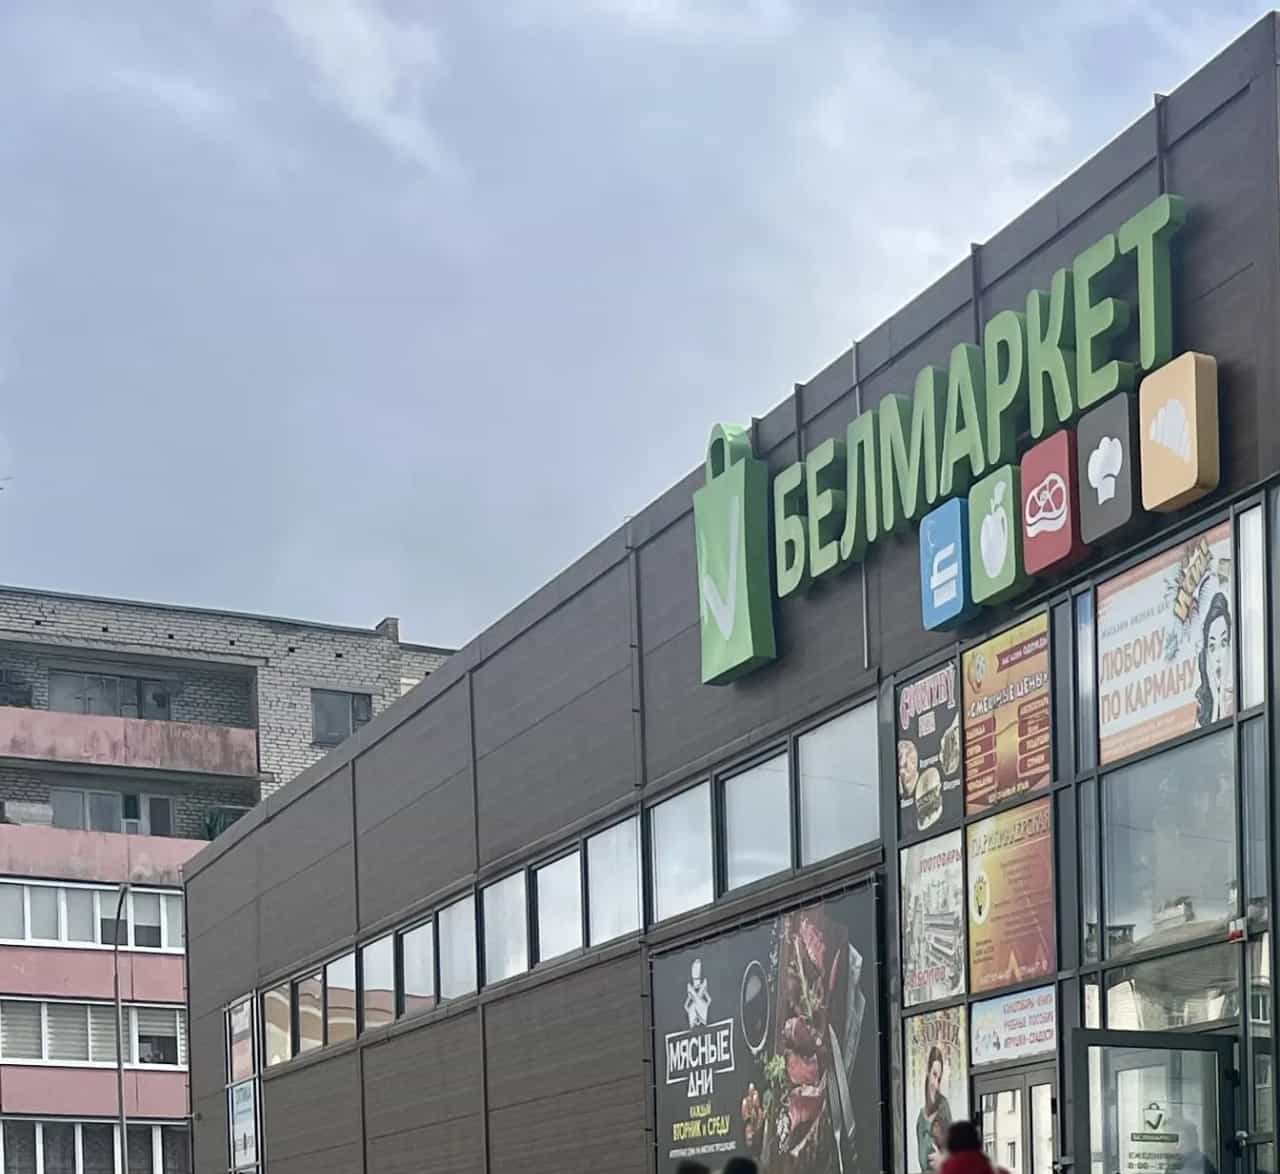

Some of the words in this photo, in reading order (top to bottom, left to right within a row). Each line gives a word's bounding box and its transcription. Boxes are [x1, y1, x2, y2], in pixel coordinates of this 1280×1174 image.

[774, 193, 1184, 598] БЕЛМАРКЕТ
[1100, 627, 1166, 684] ЛЮБОМУ
[1101, 690, 1121, 725] ПО
[1125, 656, 1197, 714] КАРМАНУ
[668, 1029, 731, 1073] МЯСНЫЕ
[687, 1068, 714, 1098] ДНИ
[707, 1115, 730, 1137] СРЕДУ
